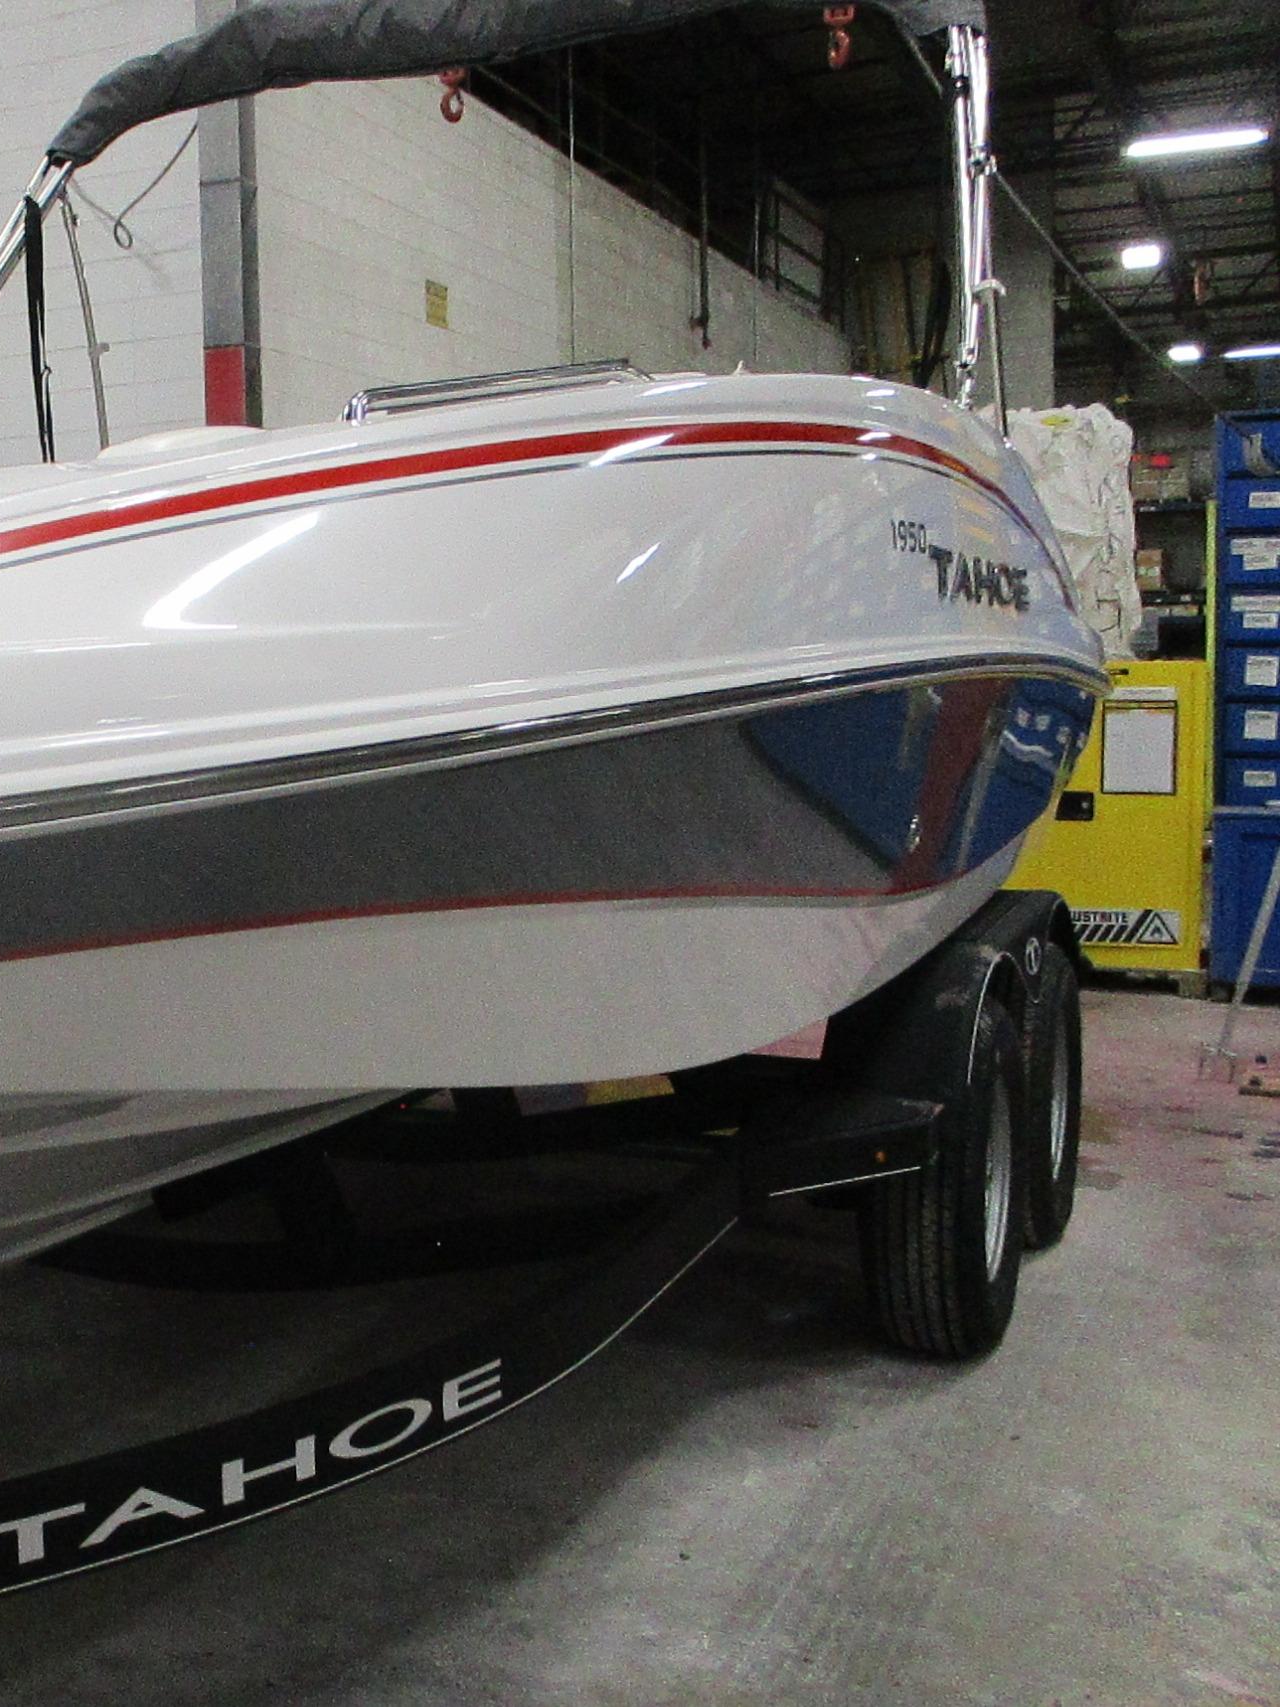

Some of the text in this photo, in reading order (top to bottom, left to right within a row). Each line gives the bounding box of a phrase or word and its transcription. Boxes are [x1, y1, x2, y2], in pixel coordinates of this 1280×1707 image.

[890, 519, 927, 554] 1950
[927, 544, 1030, 611] TAHOE
[1071, 911, 1129, 923] USTRITE
